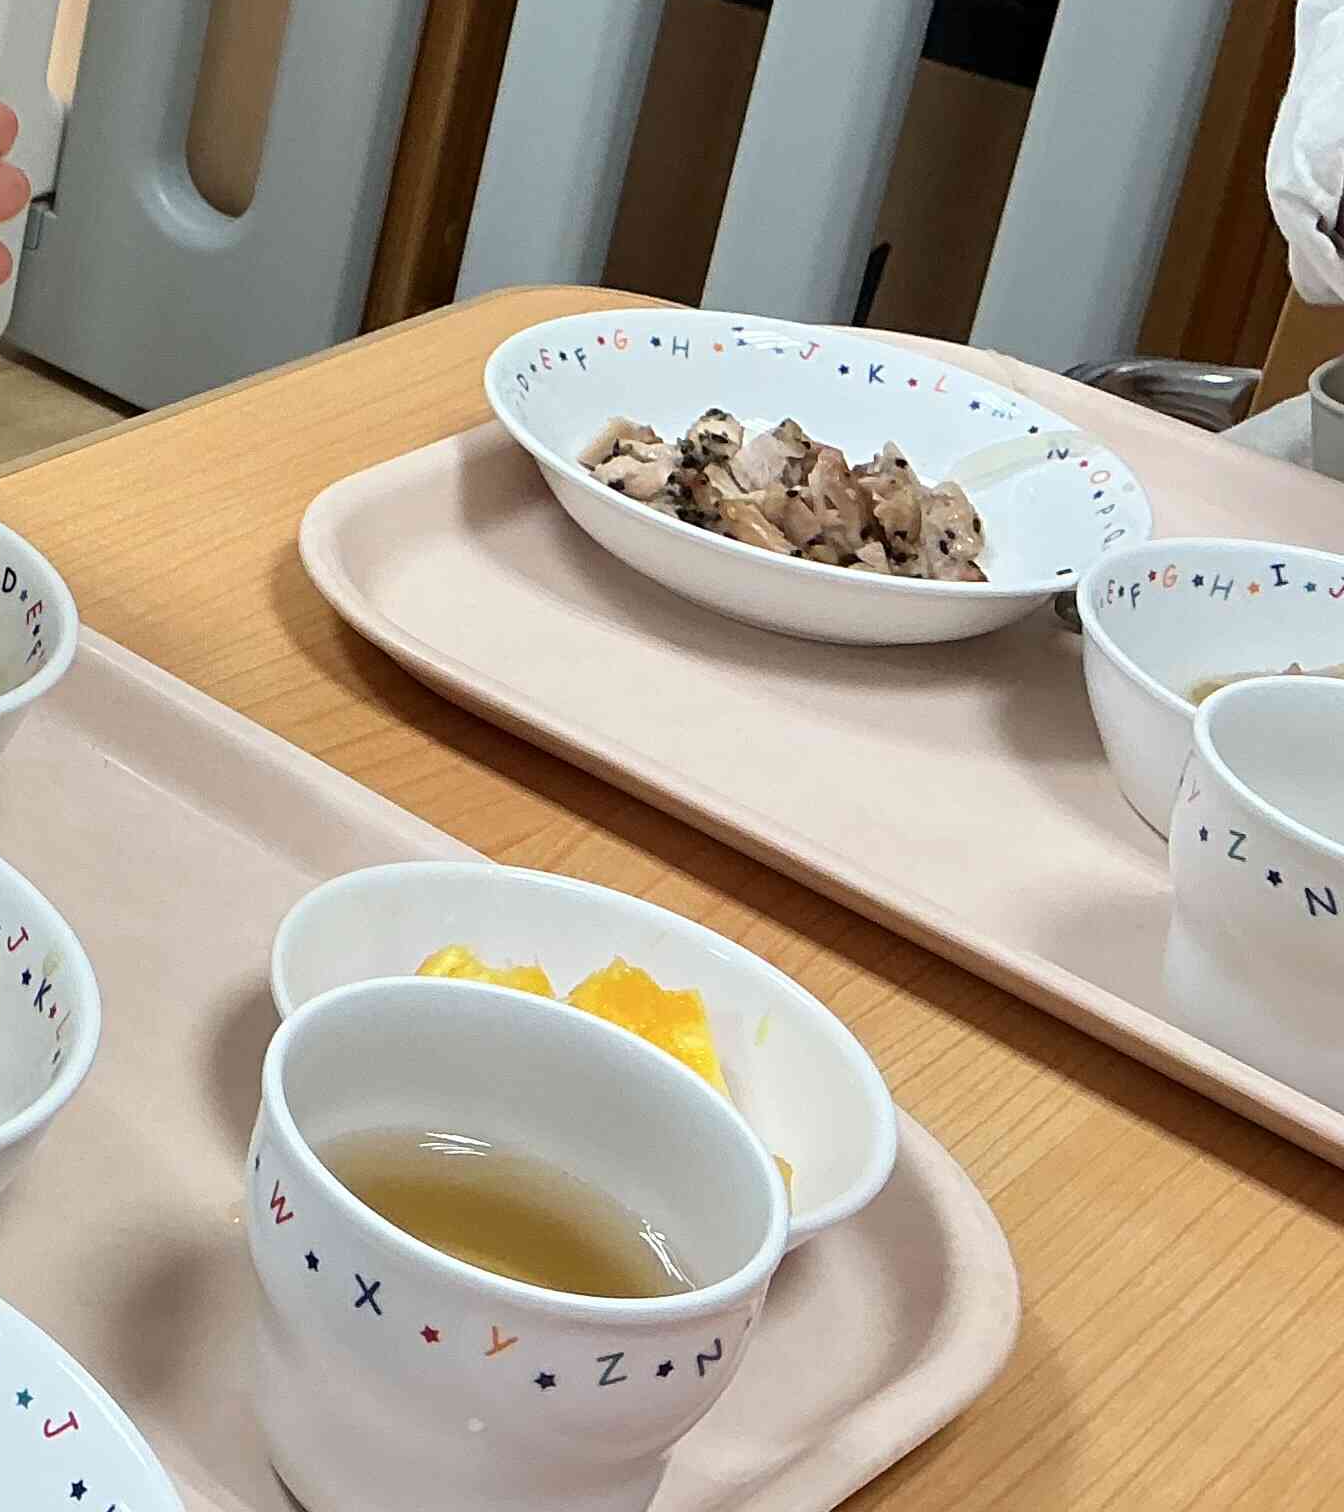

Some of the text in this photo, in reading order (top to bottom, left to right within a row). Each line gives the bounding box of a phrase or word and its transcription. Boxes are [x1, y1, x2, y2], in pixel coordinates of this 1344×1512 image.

[539, 348, 552, 370] E
[574, 348, 586, 370] F
[614, 329, 628, 350] G
[673, 336, 689, 359] H
[799, 341, 820, 360] J
[868, 363, 885, 384] K
[933, 375, 947, 393] L
[1090, 470, 1111, 485] O
[1, 566, 17, 593] D
[1130, 583, 1140, 609] F
[1162, 564, 1178, 588] G
[1210, 574, 1234, 600] H
[1269, 563, 1289, 586] I
[25, 600, 42, 625] E
[26, 639, 42, 663] F
[1228, 829, 1247, 862] Z
[1304, 886, 1338, 917] N
[7, 926, 29, 952] J
[33, 977, 52, 1013] K
[355, 1273, 382, 1316] X
[485, 1326, 519, 1357] Y
[596, 1352, 628, 1386] Z
[43, 1410, 80, 1439] J
